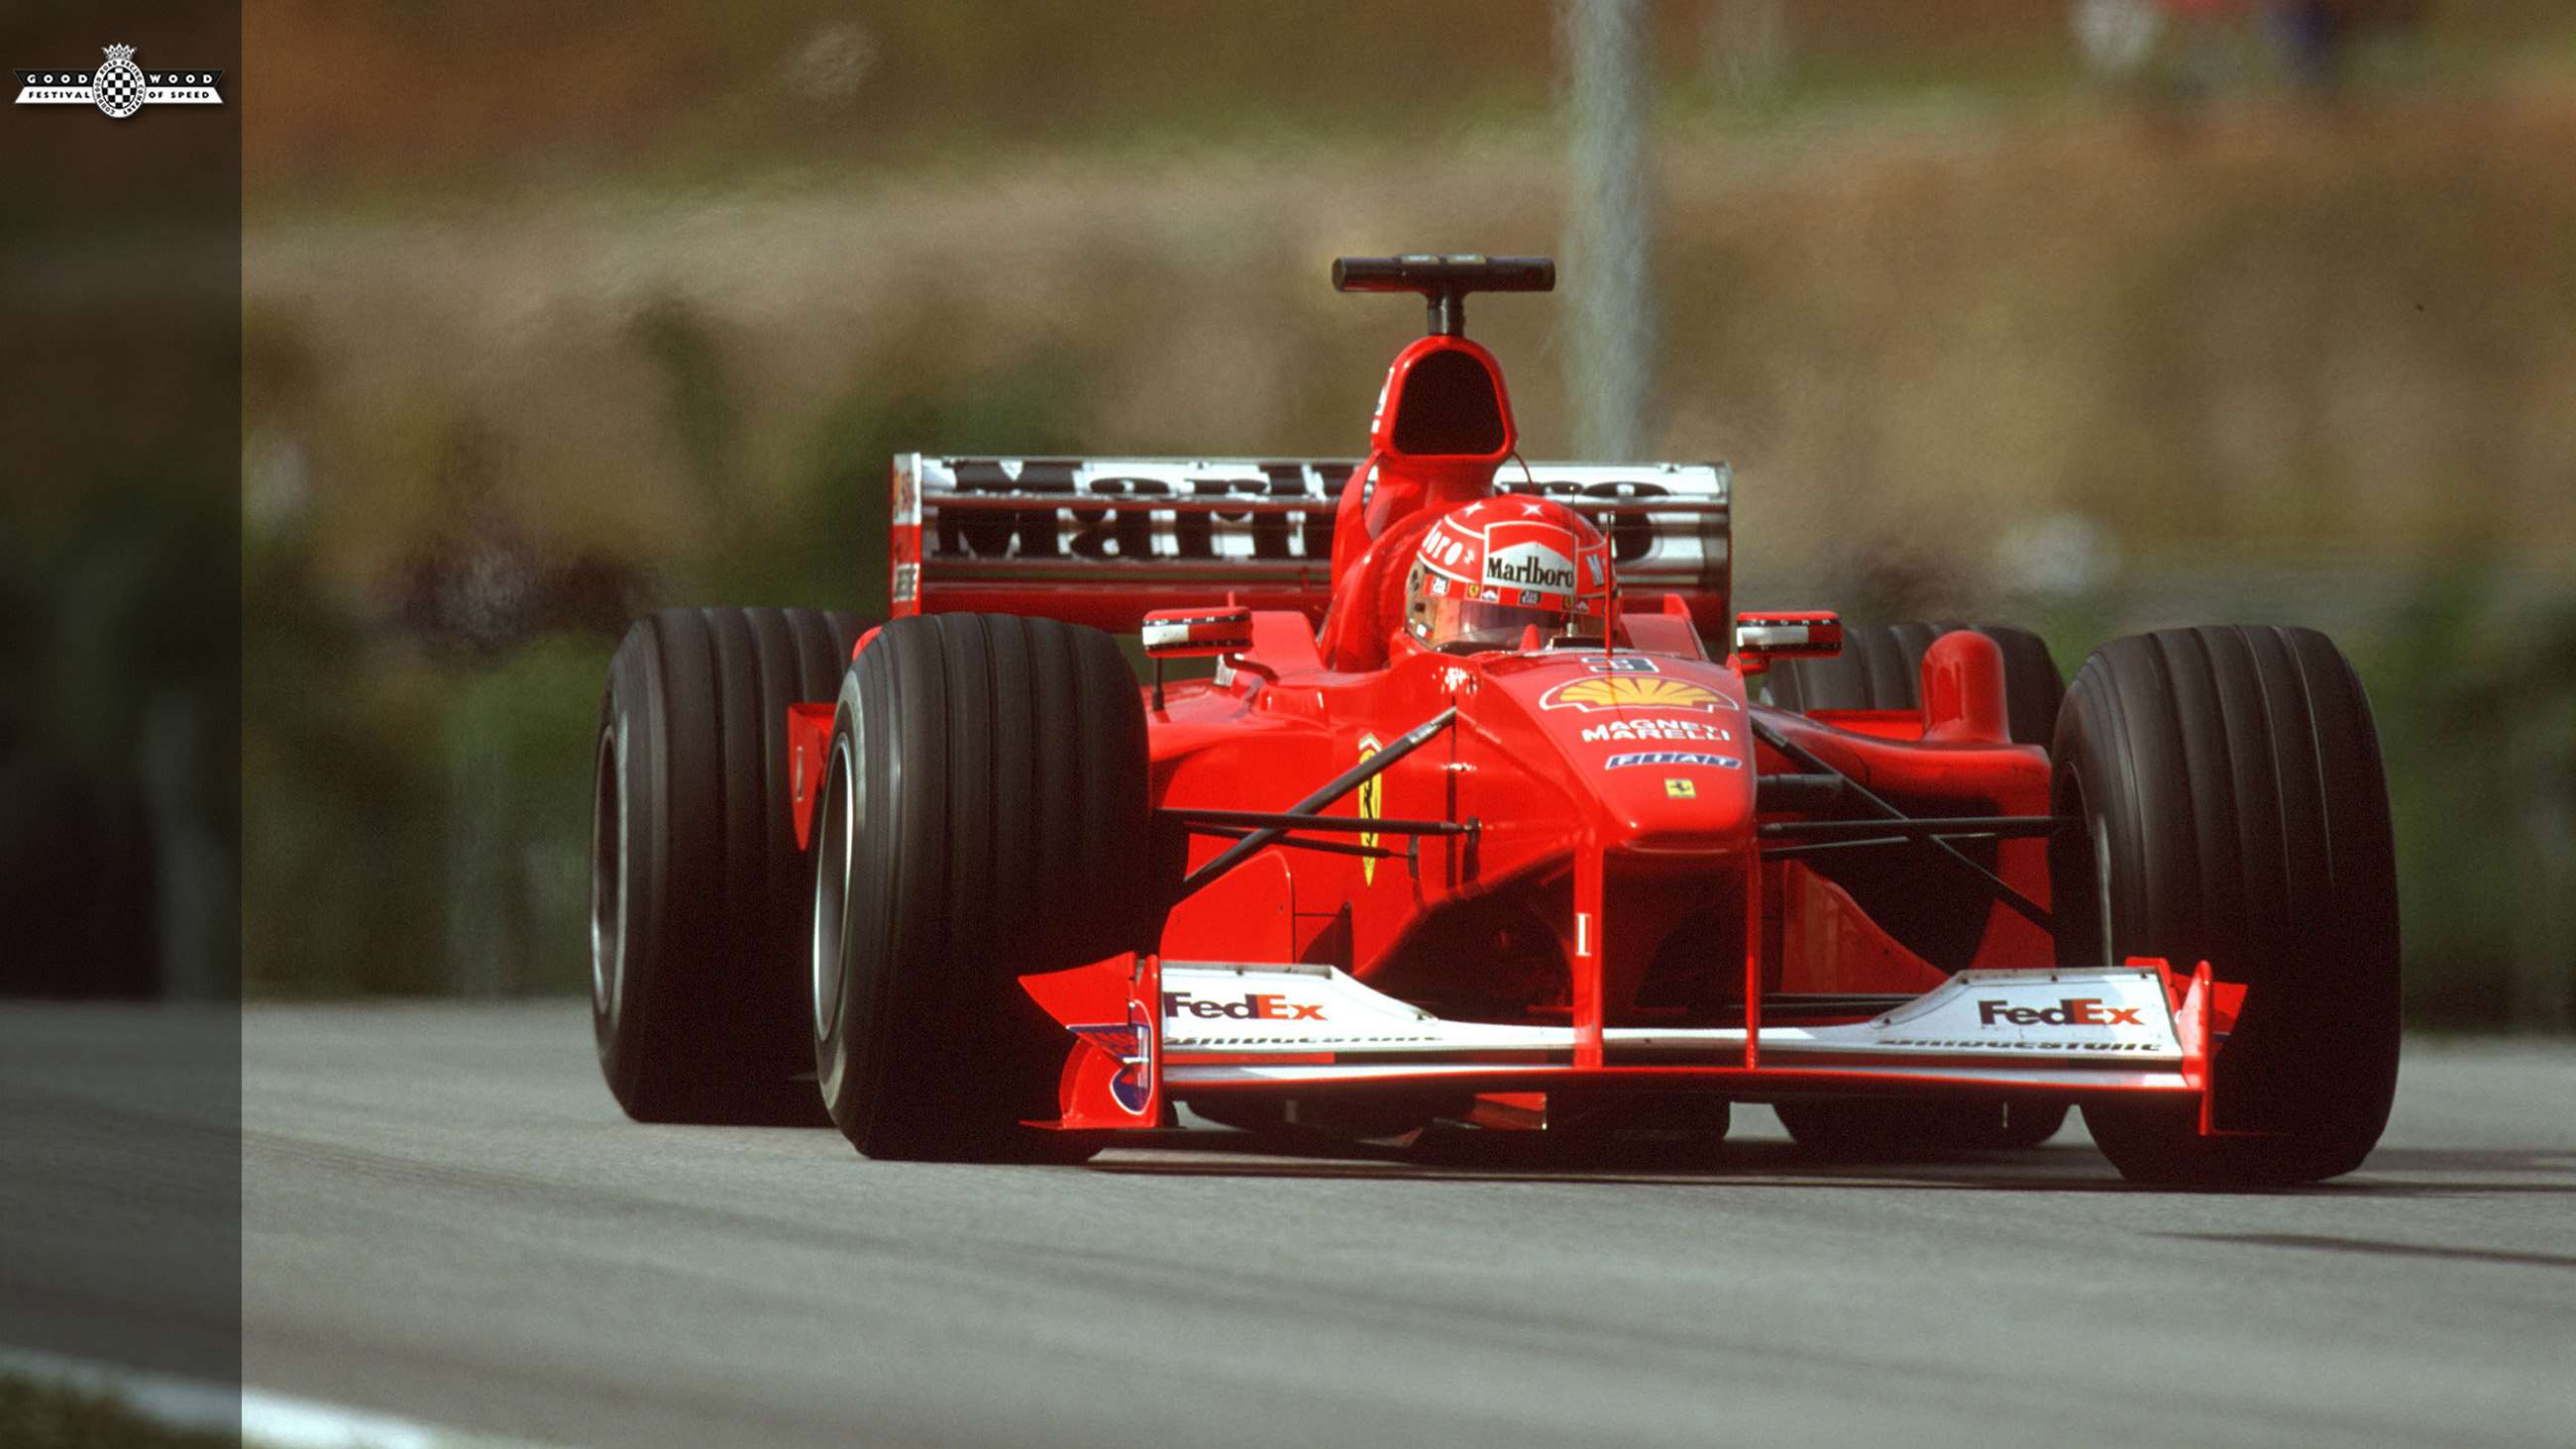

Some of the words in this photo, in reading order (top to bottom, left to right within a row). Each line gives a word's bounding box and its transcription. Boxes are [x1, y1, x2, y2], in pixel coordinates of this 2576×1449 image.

[1487, 556, 1573, 588] Marlboro
[1581, 719, 1732, 737] MAGNETI
[1581, 725, 1732, 743] MARELLI
[1613, 752, 1732, 768] FIAT
[1163, 992, 1328, 1020] FedEx
[1978, 998, 2145, 1025] FedEx
